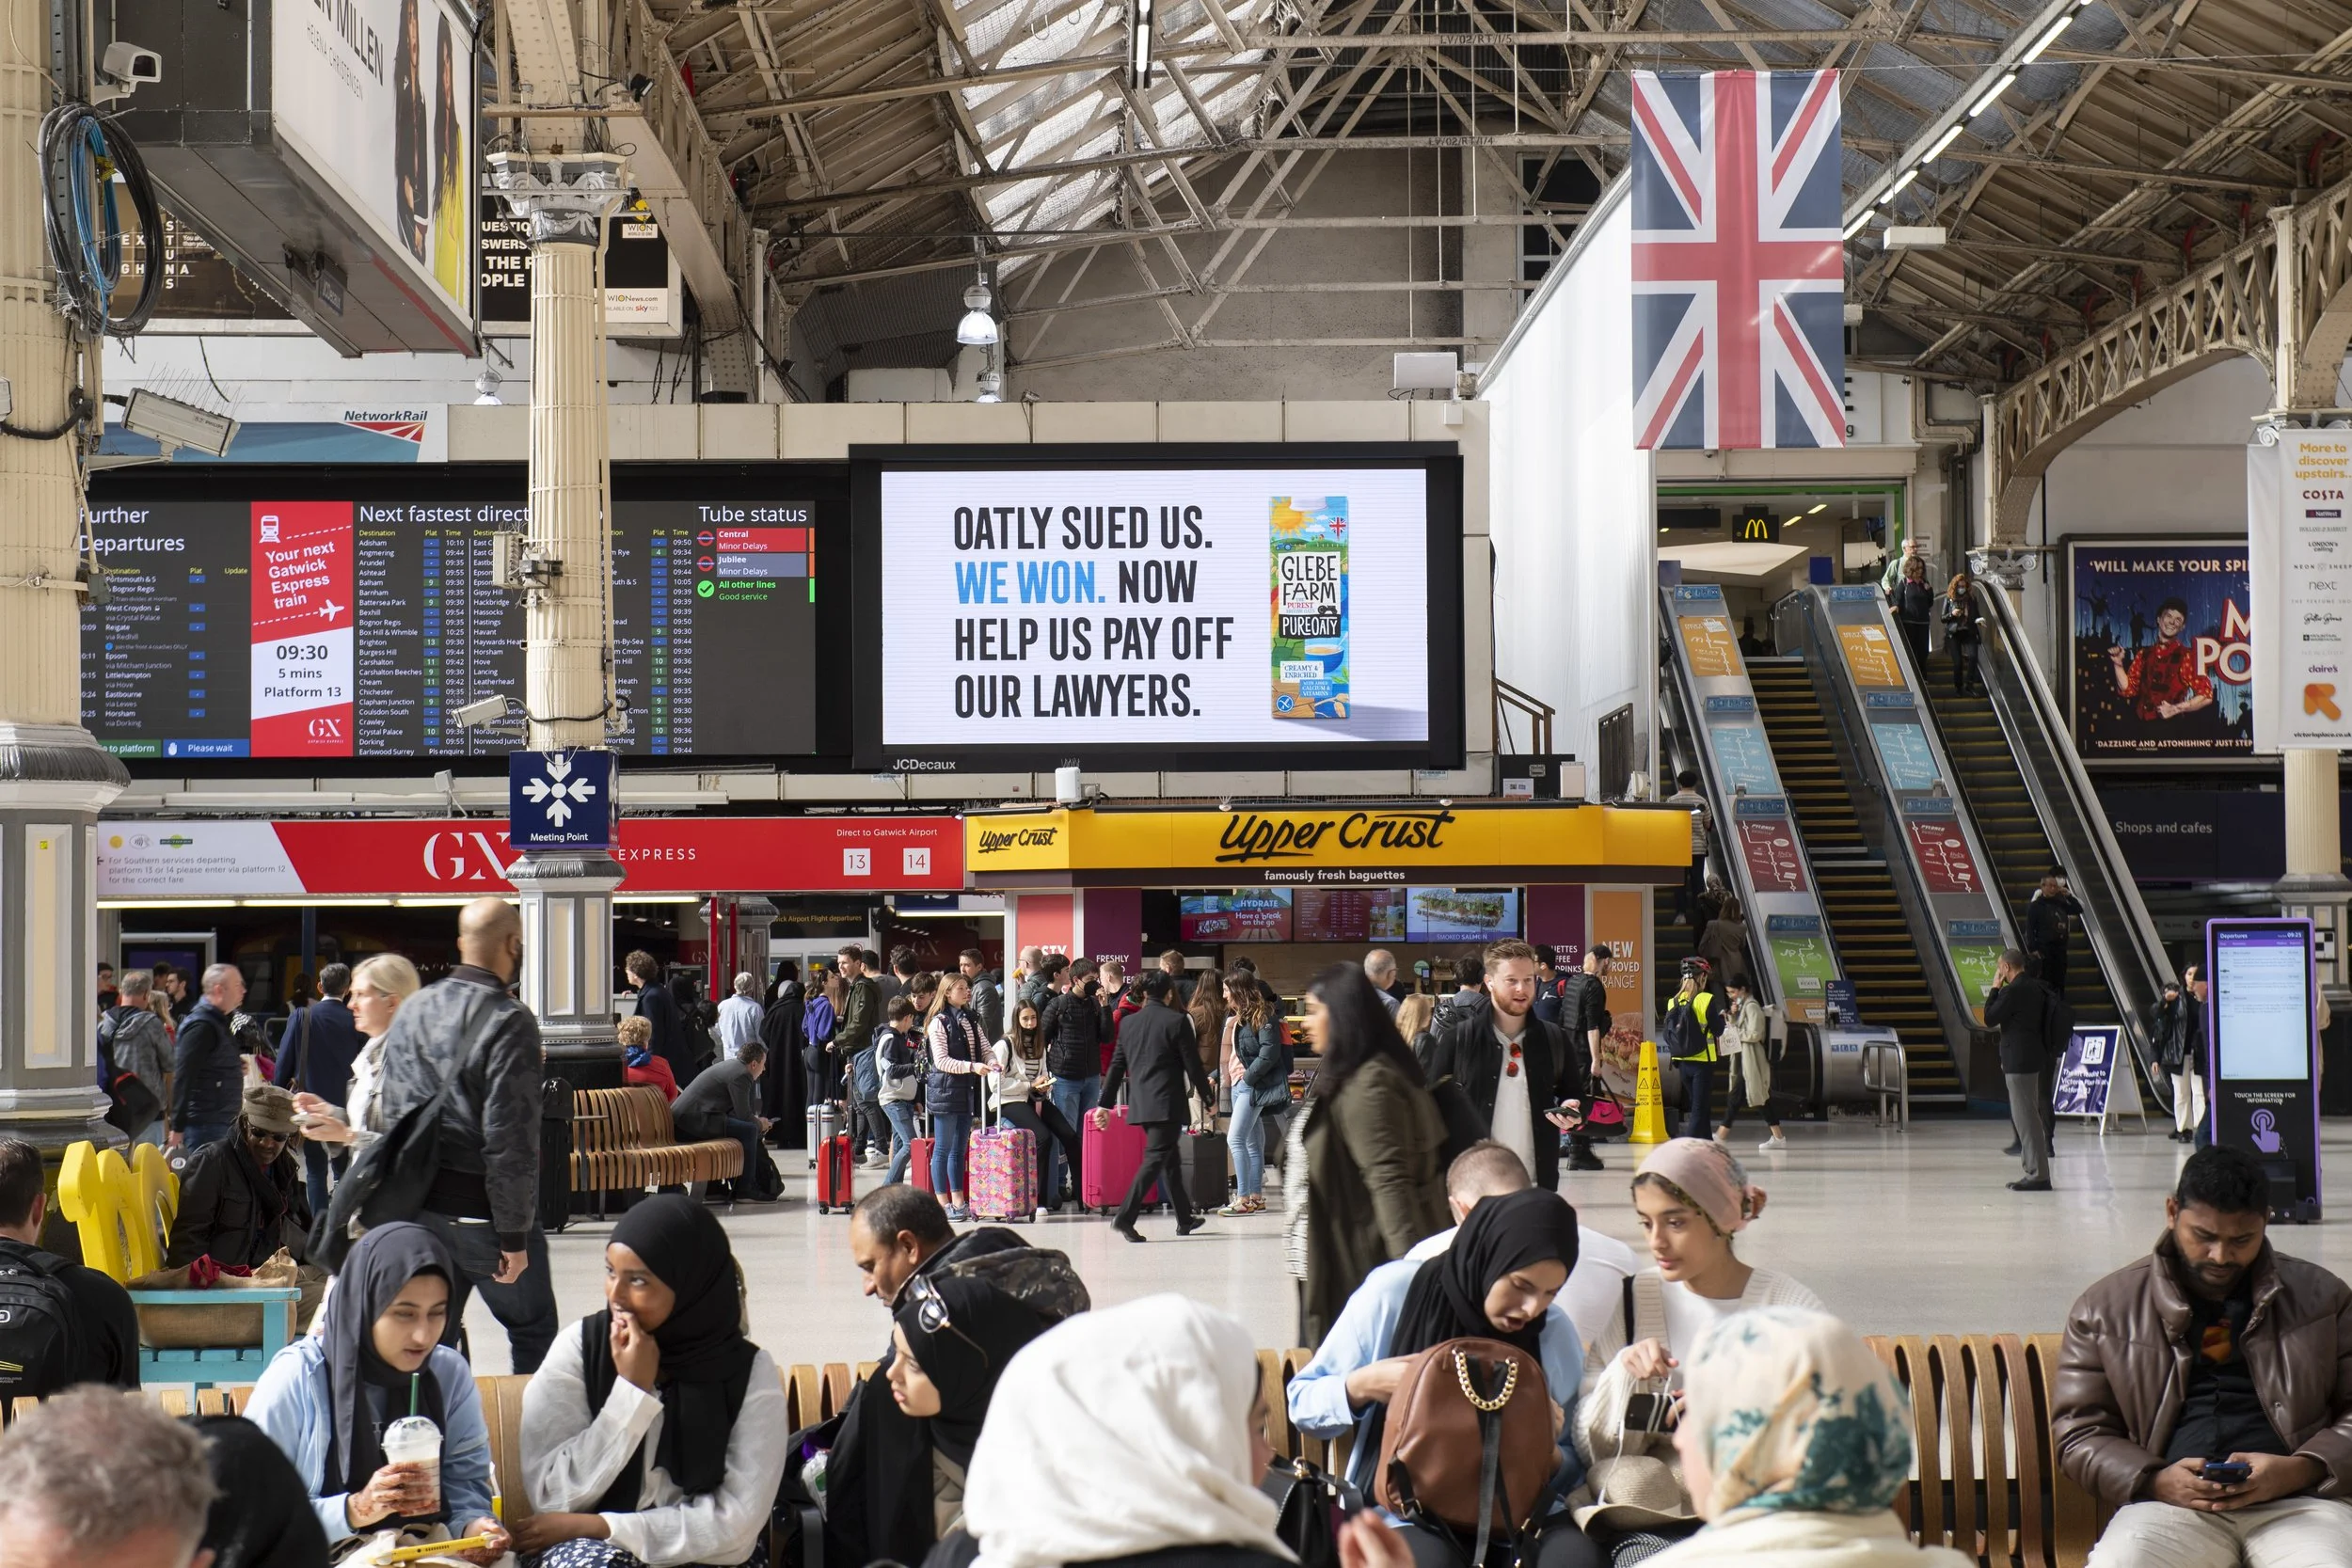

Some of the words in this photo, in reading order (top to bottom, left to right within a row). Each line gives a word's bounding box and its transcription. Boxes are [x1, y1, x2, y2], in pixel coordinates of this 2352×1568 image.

[337, 0, 384, 87] MILLEN
[307, 20, 327, 59] HELENA
[329, 47, 364, 102] CHRISTENSEN
[485, 257, 521, 269] THE
[343, 410, 428, 421] NetworkRail
[204, 420, 224, 430] PHILIPS
[2298, 456, 2349, 466] discover
[2302, 490, 2344, 500] COSTA
[79, 506, 150, 524] Further
[359, 506, 404, 522] Next
[408, 505, 472, 523] fastest
[699, 506, 744, 522] Tube
[751, 507, 807, 522] status
[954, 506, 1053, 551] OATLY
[1061, 506, 1149, 551] SUED
[1161, 506, 1214, 551] US.
[79, 534, 185, 556] Departures
[743, 543, 768, 551] Delays
[265, 546, 301, 564] Your
[303, 541, 336, 558] next
[719, 556, 747, 564] Jubilee
[2133, 561, 2173, 572] MAKE
[2178, 561, 2220, 572] YOUR
[268, 559, 327, 580] Gatwick
[1281, 555, 1337, 581] GLEBE
[271, 575, 330, 595] Express
[956, 561, 1009, 605] WE
[1016, 561, 1105, 605] WON.
[1120, 561, 1198, 605] NOW
[2309, 581, 2338, 591] next
[1283, 582, 1336, 606] FARM
[274, 593, 308, 610] train
[1282, 616, 1338, 637] PUREOATY
[956, 617, 1038, 661] HELP
[1049, 617, 1092, 661] US
[1104, 617, 1162, 661] PAY
[1171, 617, 1234, 661] OFF
[277, 645, 328, 660] 09:30
[278, 668, 286, 679] 5
[289, 668, 323, 679] mins
[2309, 665, 2338, 673] claire's
[264, 686, 322, 698] Platform
[326, 687, 342, 698] 13
[954, 674, 1021, 719] OUR
[1033, 674, 1201, 719] LAWYERS.
[309, 719, 341, 737] GX
[119, 744, 155, 754] platform
[188, 744, 215, 752] Please
[215, 744, 233, 752] wait
[893, 760, 956, 771] JCDecaux
[874, 828, 906, 836] Gatwick
[909, 828, 938, 838] Airport
[2115, 821, 2153, 835] Shops
[2155, 821, 2177, 833] and
[2180, 821, 2213, 833] cafes
[530, 832, 564, 843] Meeting
[566, 832, 588, 841] Point
[978, 830, 1016, 853] Upper
[1019, 827, 1057, 847] Crust
[1216, 814, 1335, 863] Upper
[1339, 812, 1455, 848] Crust
[197, 856, 236, 865] departing
[618, 848, 696, 861] EXPRESS
[848, 853, 866, 870] 13
[908, 853, 927, 870] 14
[108, 866, 143, 875] platform
[177, 866, 202, 875] please
[242, 866, 276, 875] platform
[1264, 869, 1314, 882] famously
[1317, 869, 1345, 880] fresh
[1348, 869, 1406, 882] baguettes
[811, 915, 828, 924] Flight
[1262, 911, 1282, 920] break
[1601, 974, 1635, 988] RANGE
